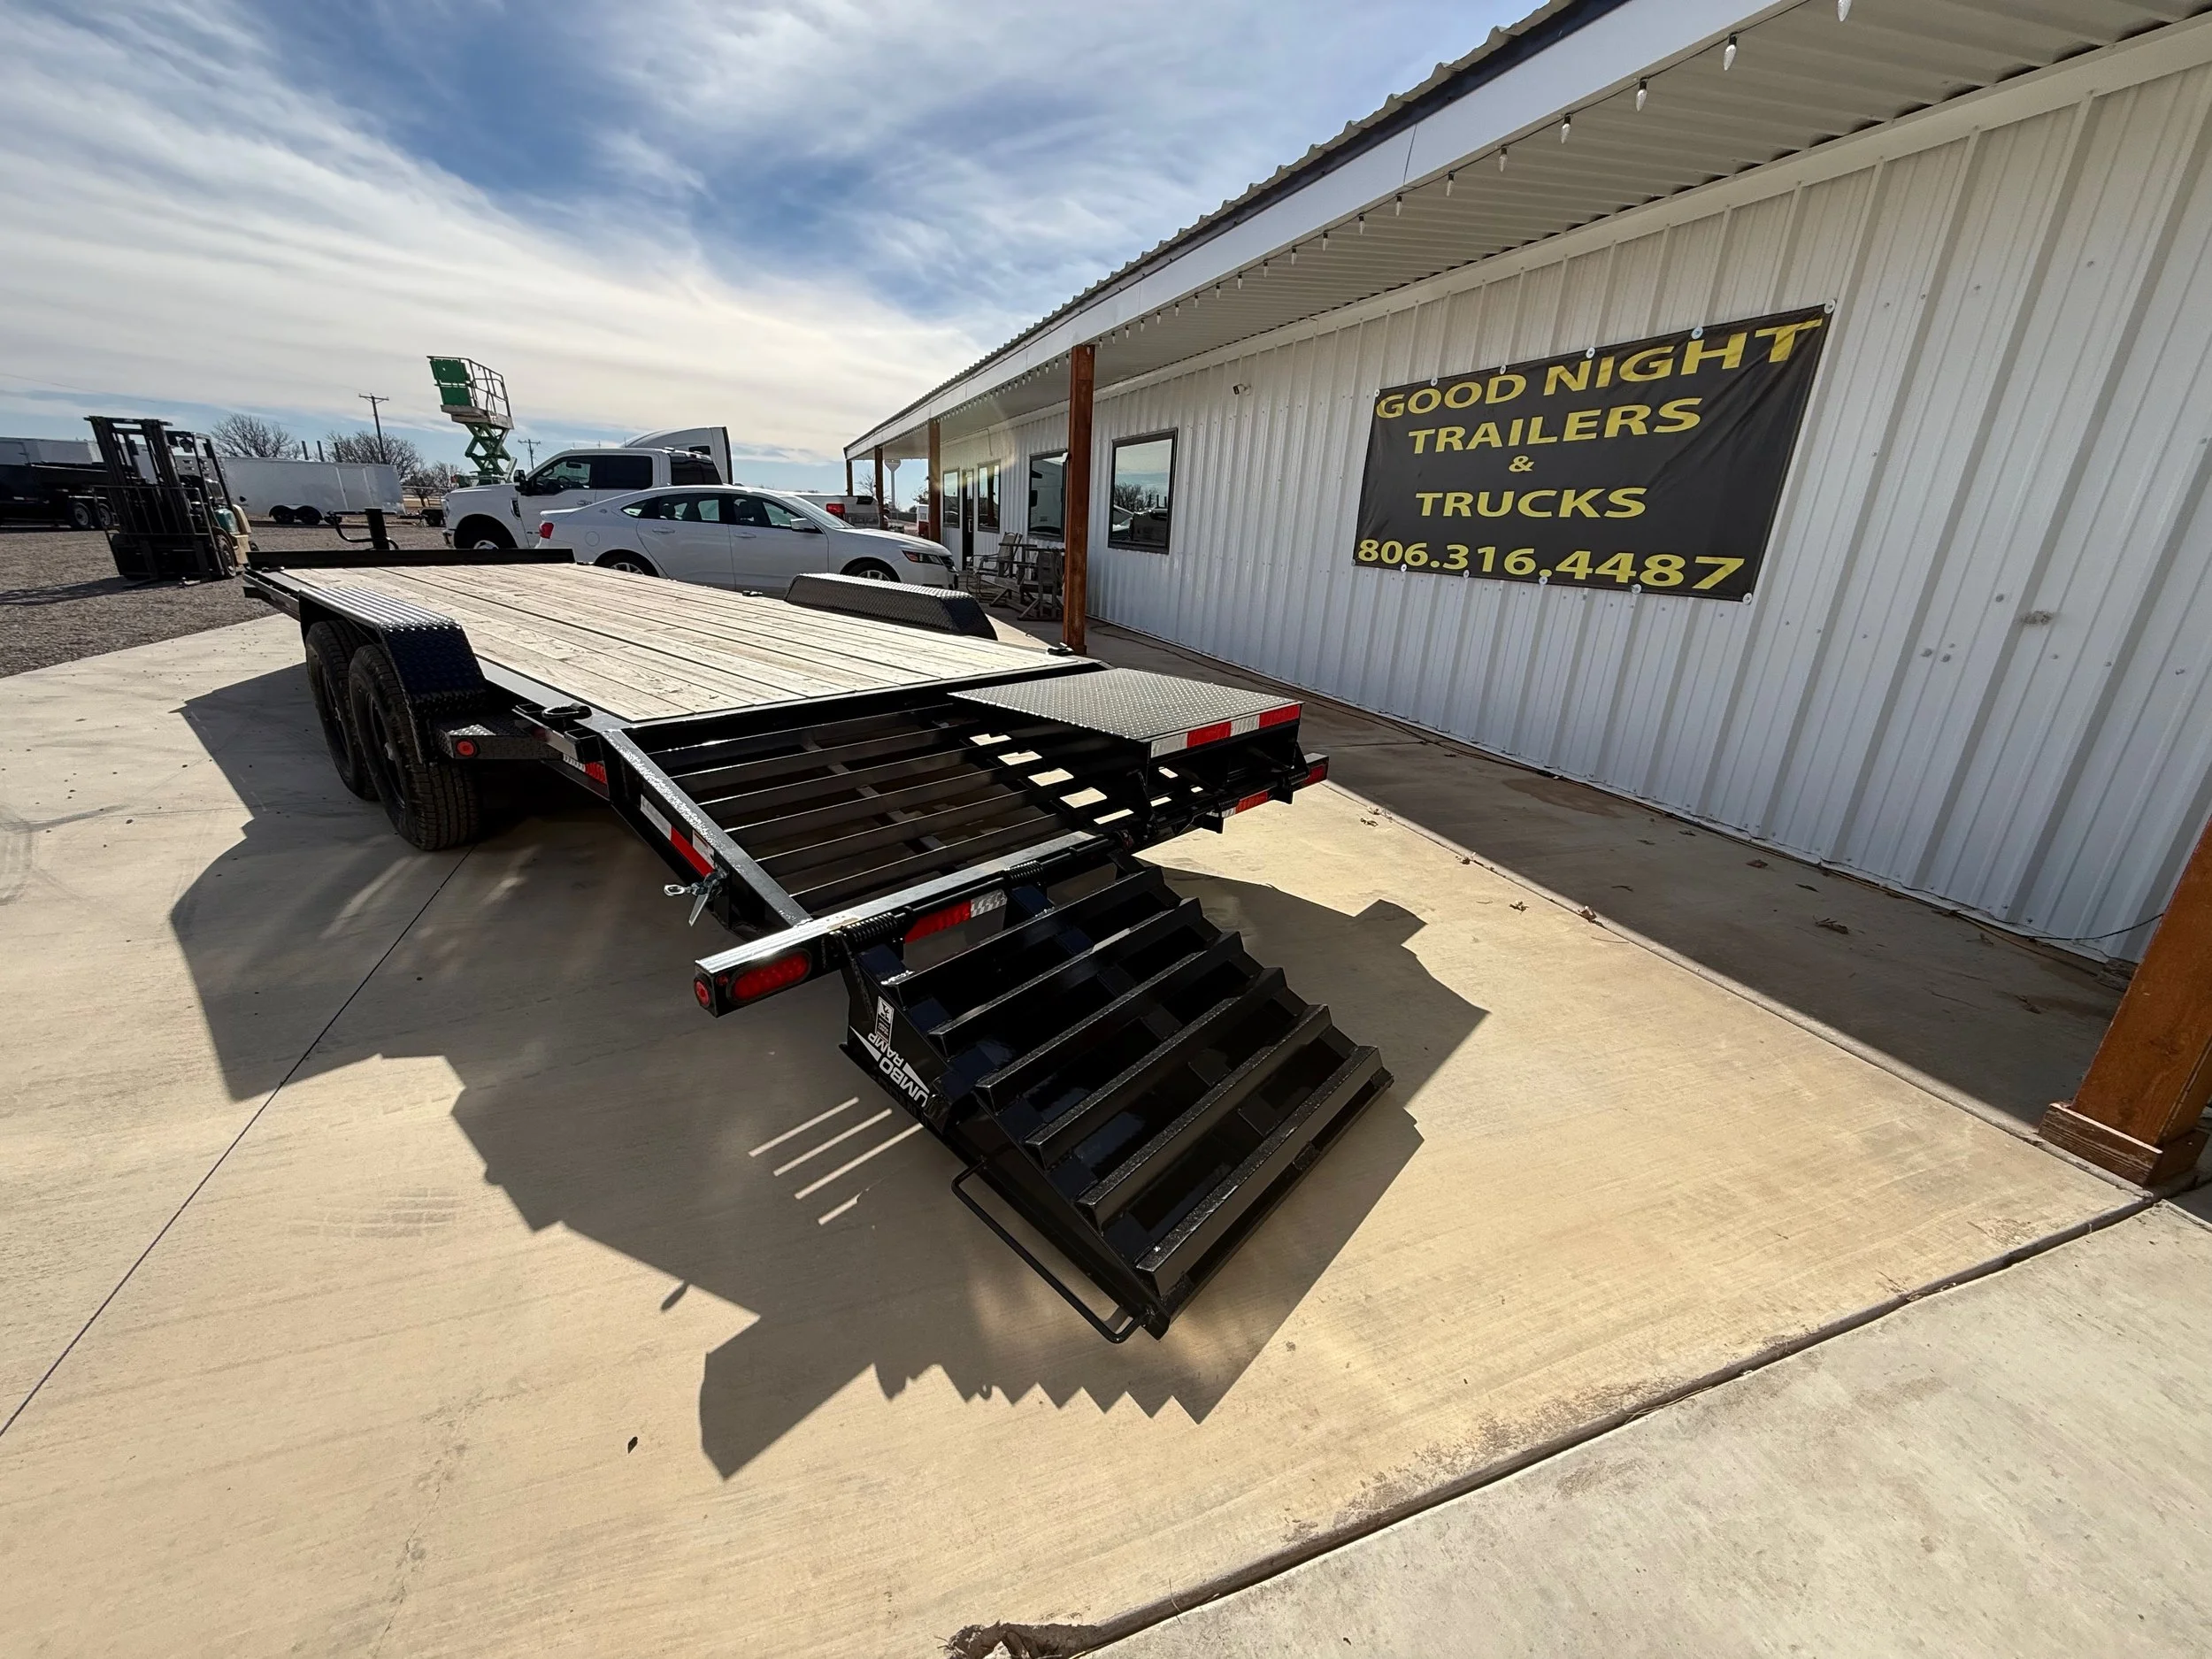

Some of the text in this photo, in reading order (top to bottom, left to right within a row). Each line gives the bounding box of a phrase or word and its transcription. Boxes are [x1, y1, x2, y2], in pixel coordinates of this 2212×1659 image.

[1376, 319, 1823, 419] GOOD NIGHT
[1409, 397, 1702, 454] TRAILERS
[1509, 455, 1533, 472] &
[1416, 488, 1647, 518] TRUCKS
[1358, 539, 1745, 590] 806.316.4487
[868, 1033, 904, 1067] RAMP
[879, 1056, 929, 1108] UMBO
